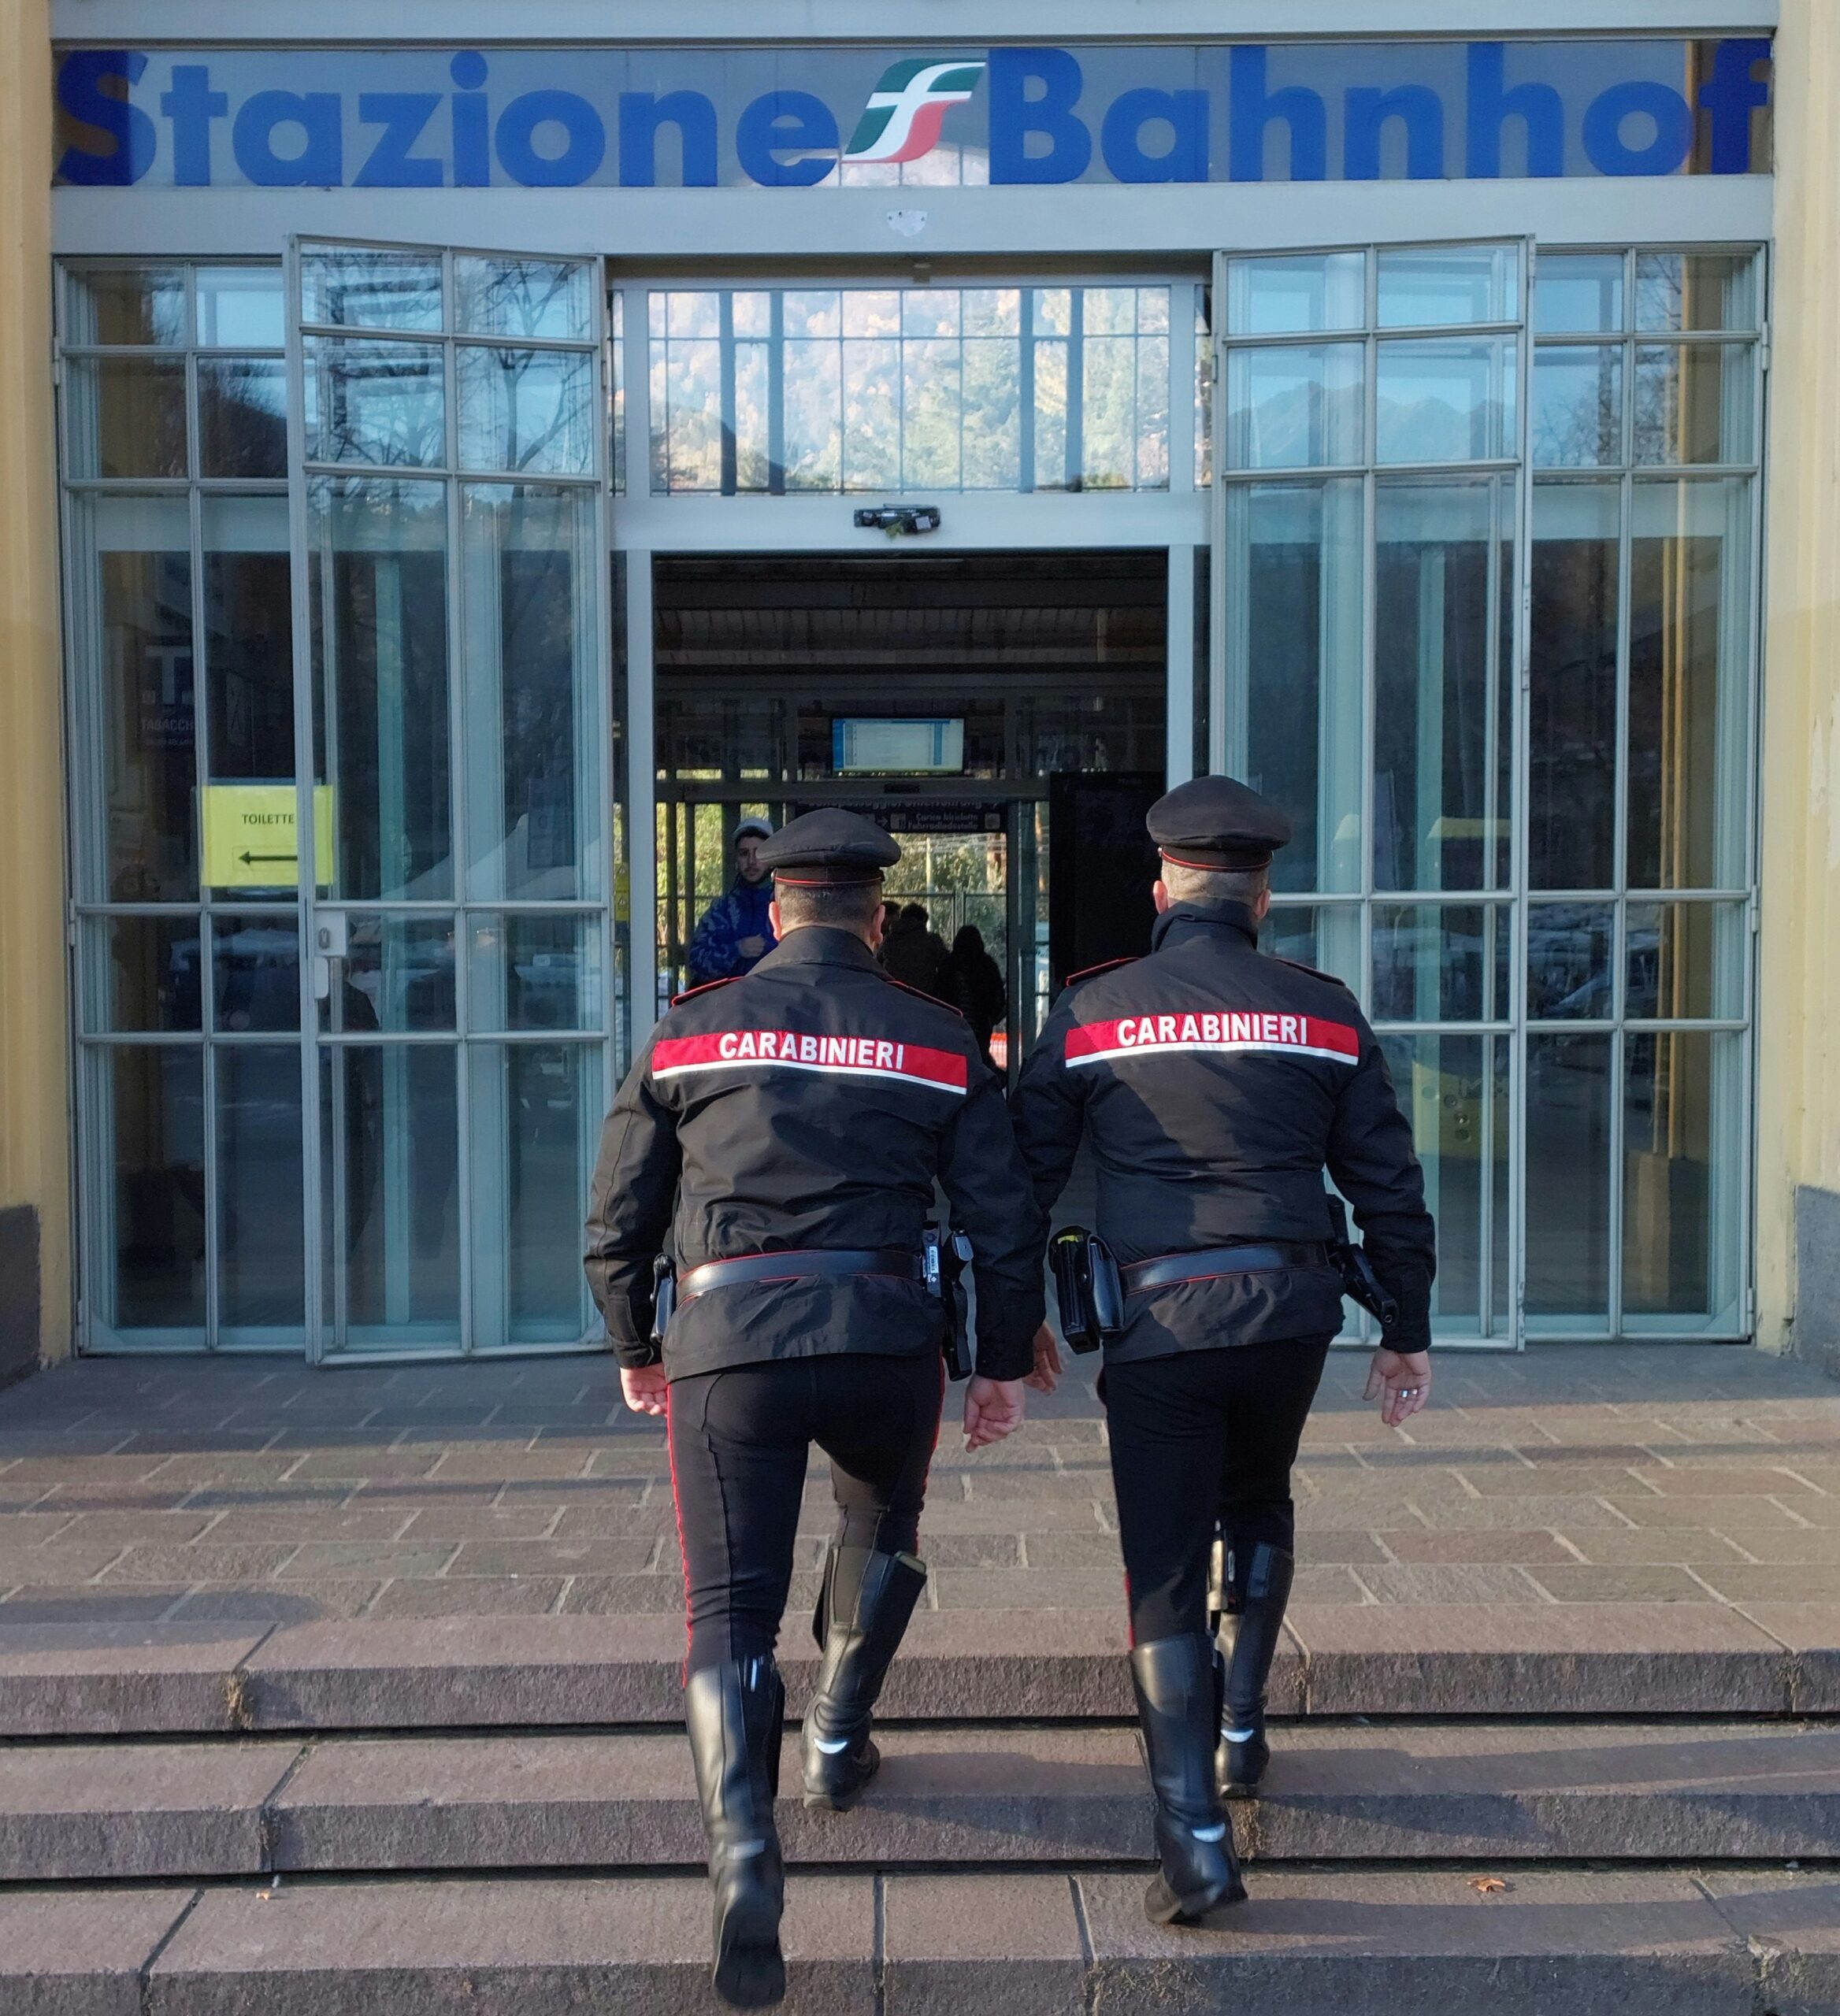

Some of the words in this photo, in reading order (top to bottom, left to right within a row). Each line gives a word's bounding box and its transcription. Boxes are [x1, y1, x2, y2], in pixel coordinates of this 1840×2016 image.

[56, 49, 840, 187] Stazione
[989, 39, 1770, 185] Bahnhof
[141, 717, 195, 732] TABACCH
[241, 813, 295, 825] TOILETTE
[1114, 1012, 1310, 1047] CARABINIERI
[718, 1030, 905, 1071] CARABINIERI
